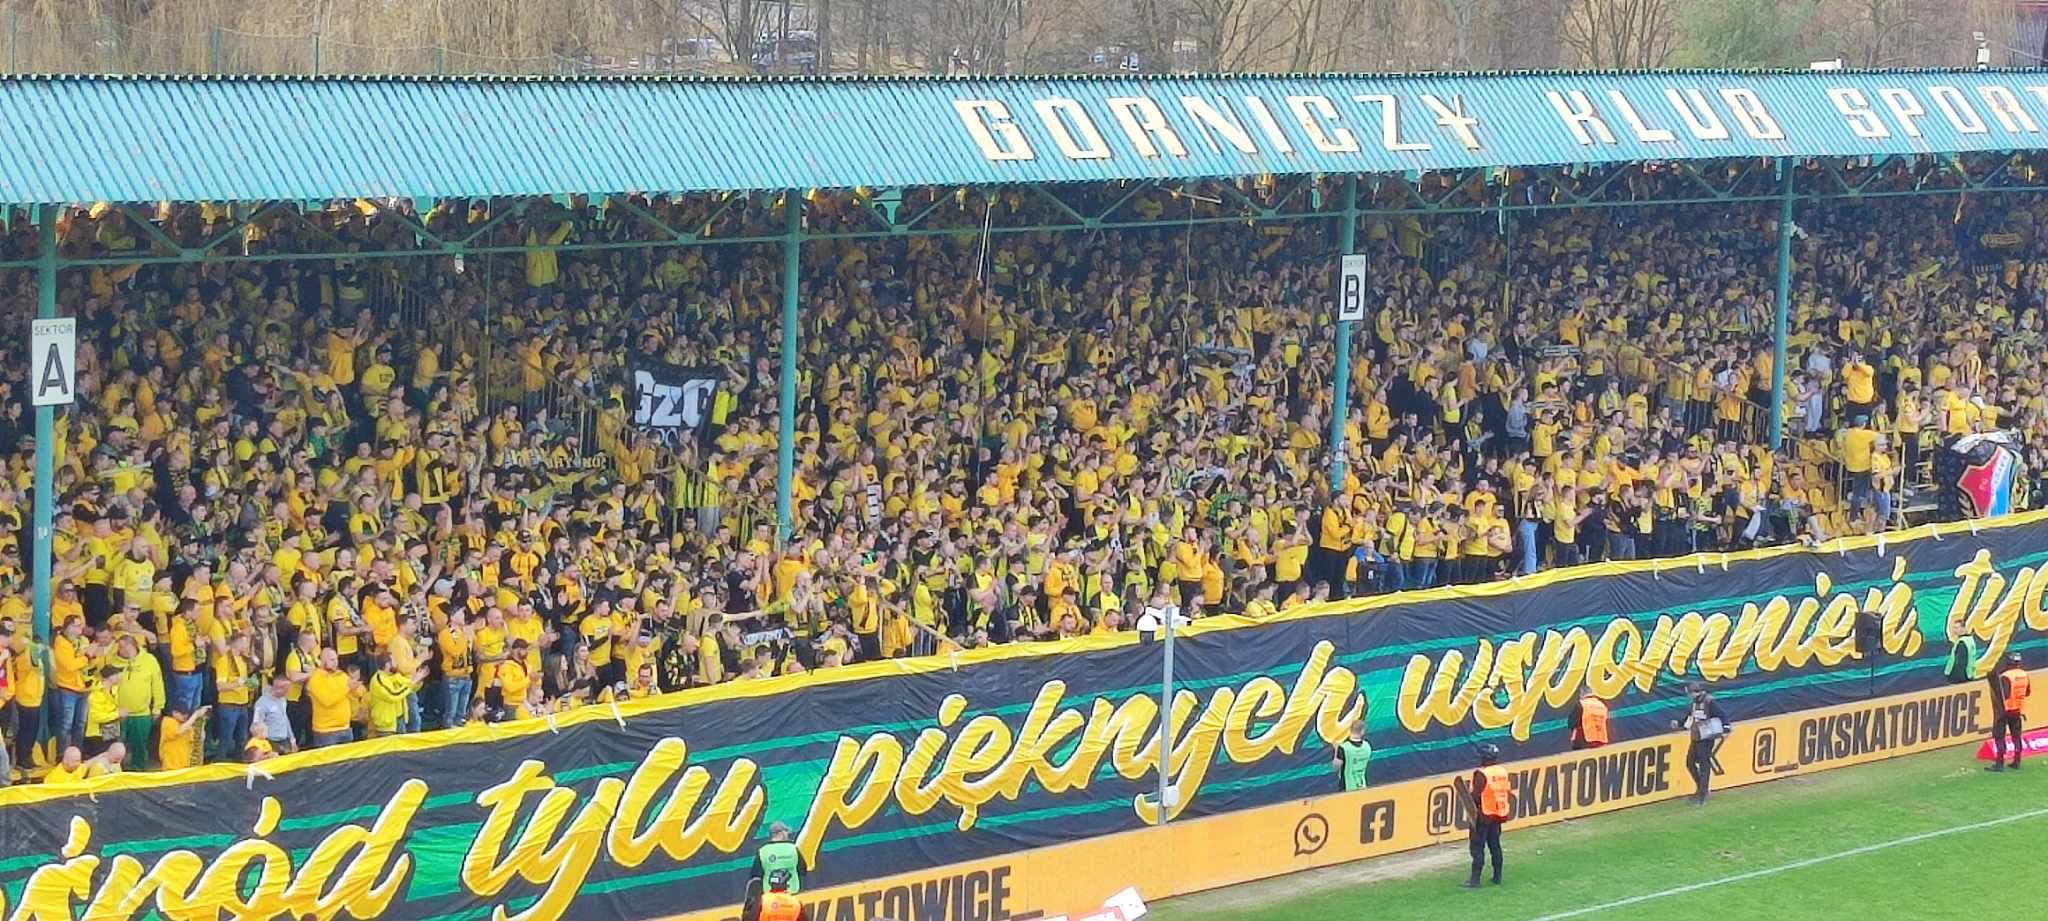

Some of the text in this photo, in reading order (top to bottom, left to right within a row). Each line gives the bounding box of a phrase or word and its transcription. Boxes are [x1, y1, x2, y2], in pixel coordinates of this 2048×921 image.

[1545, 87, 1786, 146] KLUB
[1344, 274, 1360, 313] B
[34, 324, 73, 336] SEKTOR
[38, 343, 68, 397] A
[0, 778, 429, 921] śród
[462, 736, 765, 921] tylu
[797, 640, 1364, 872] pięknych
